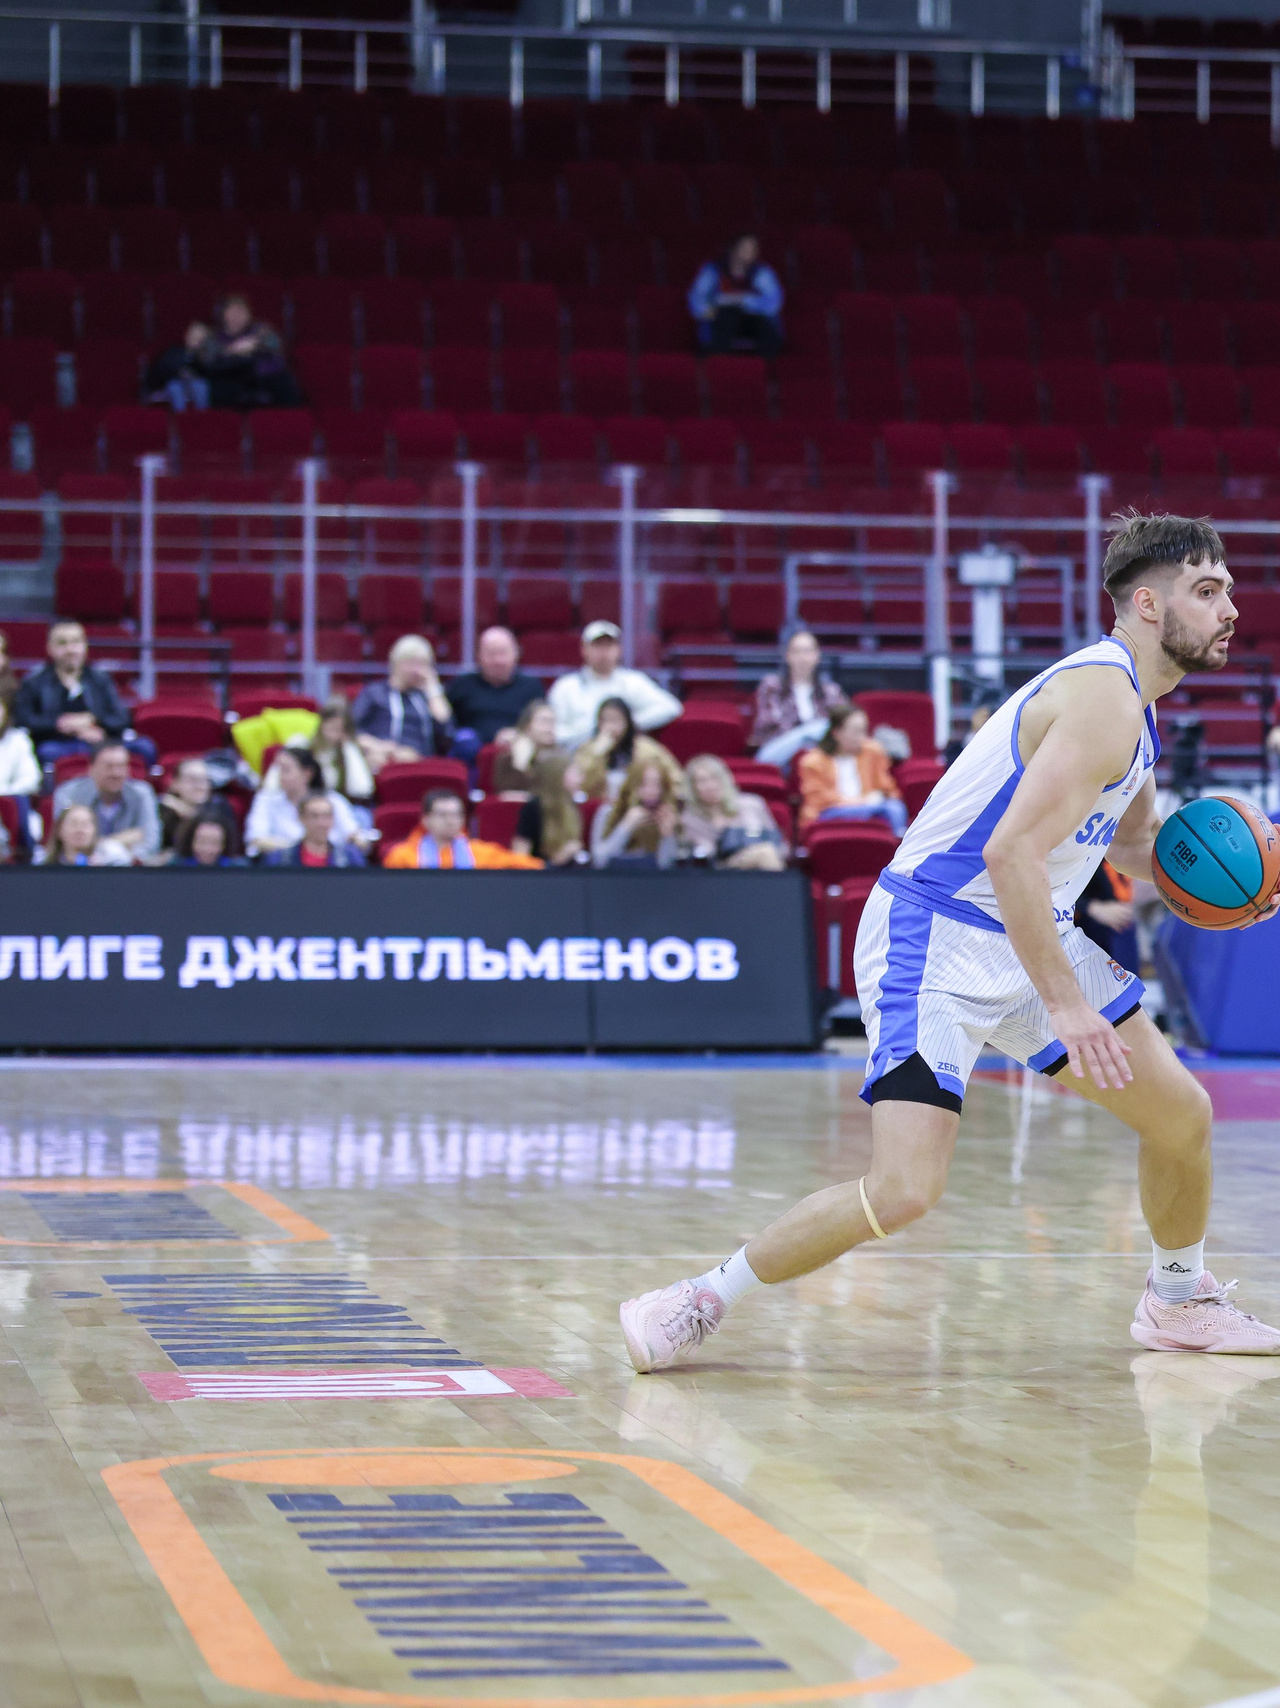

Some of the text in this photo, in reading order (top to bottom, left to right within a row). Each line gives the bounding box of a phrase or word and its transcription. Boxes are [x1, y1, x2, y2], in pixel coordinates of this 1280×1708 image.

[1170, 851, 1189, 873] APPROVED
[1174, 840, 1198, 867] FIBA
[0, 935, 740, 988] ЛИГЕ ДЖЕНТЛЬМЕНОВ
[267, 1492, 792, 1679] WINLINE
